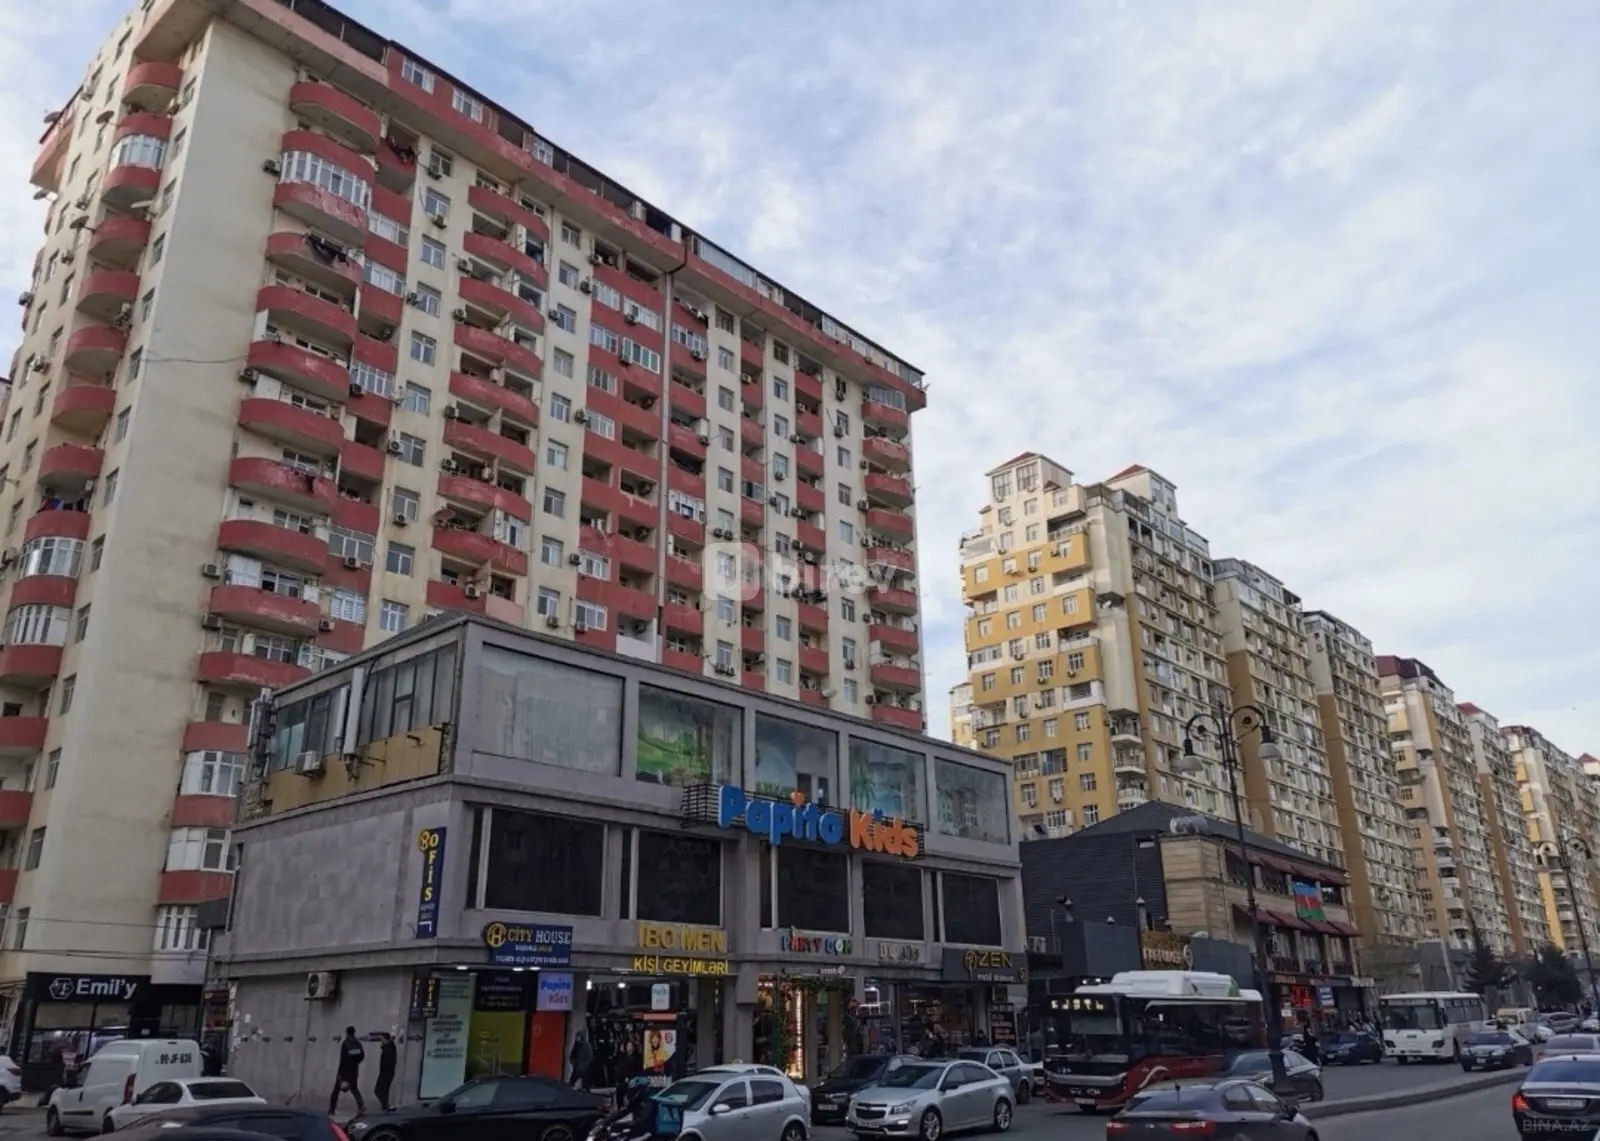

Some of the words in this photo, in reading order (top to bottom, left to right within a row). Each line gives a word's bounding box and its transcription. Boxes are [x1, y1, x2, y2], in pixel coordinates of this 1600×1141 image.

[717, 783, 844, 847] Papito
[849, 806, 920, 858] Kids
[536, 928, 572, 945] HOUSE
[681, 926, 728, 953] MEN
[539, 977, 572, 993] Papito
